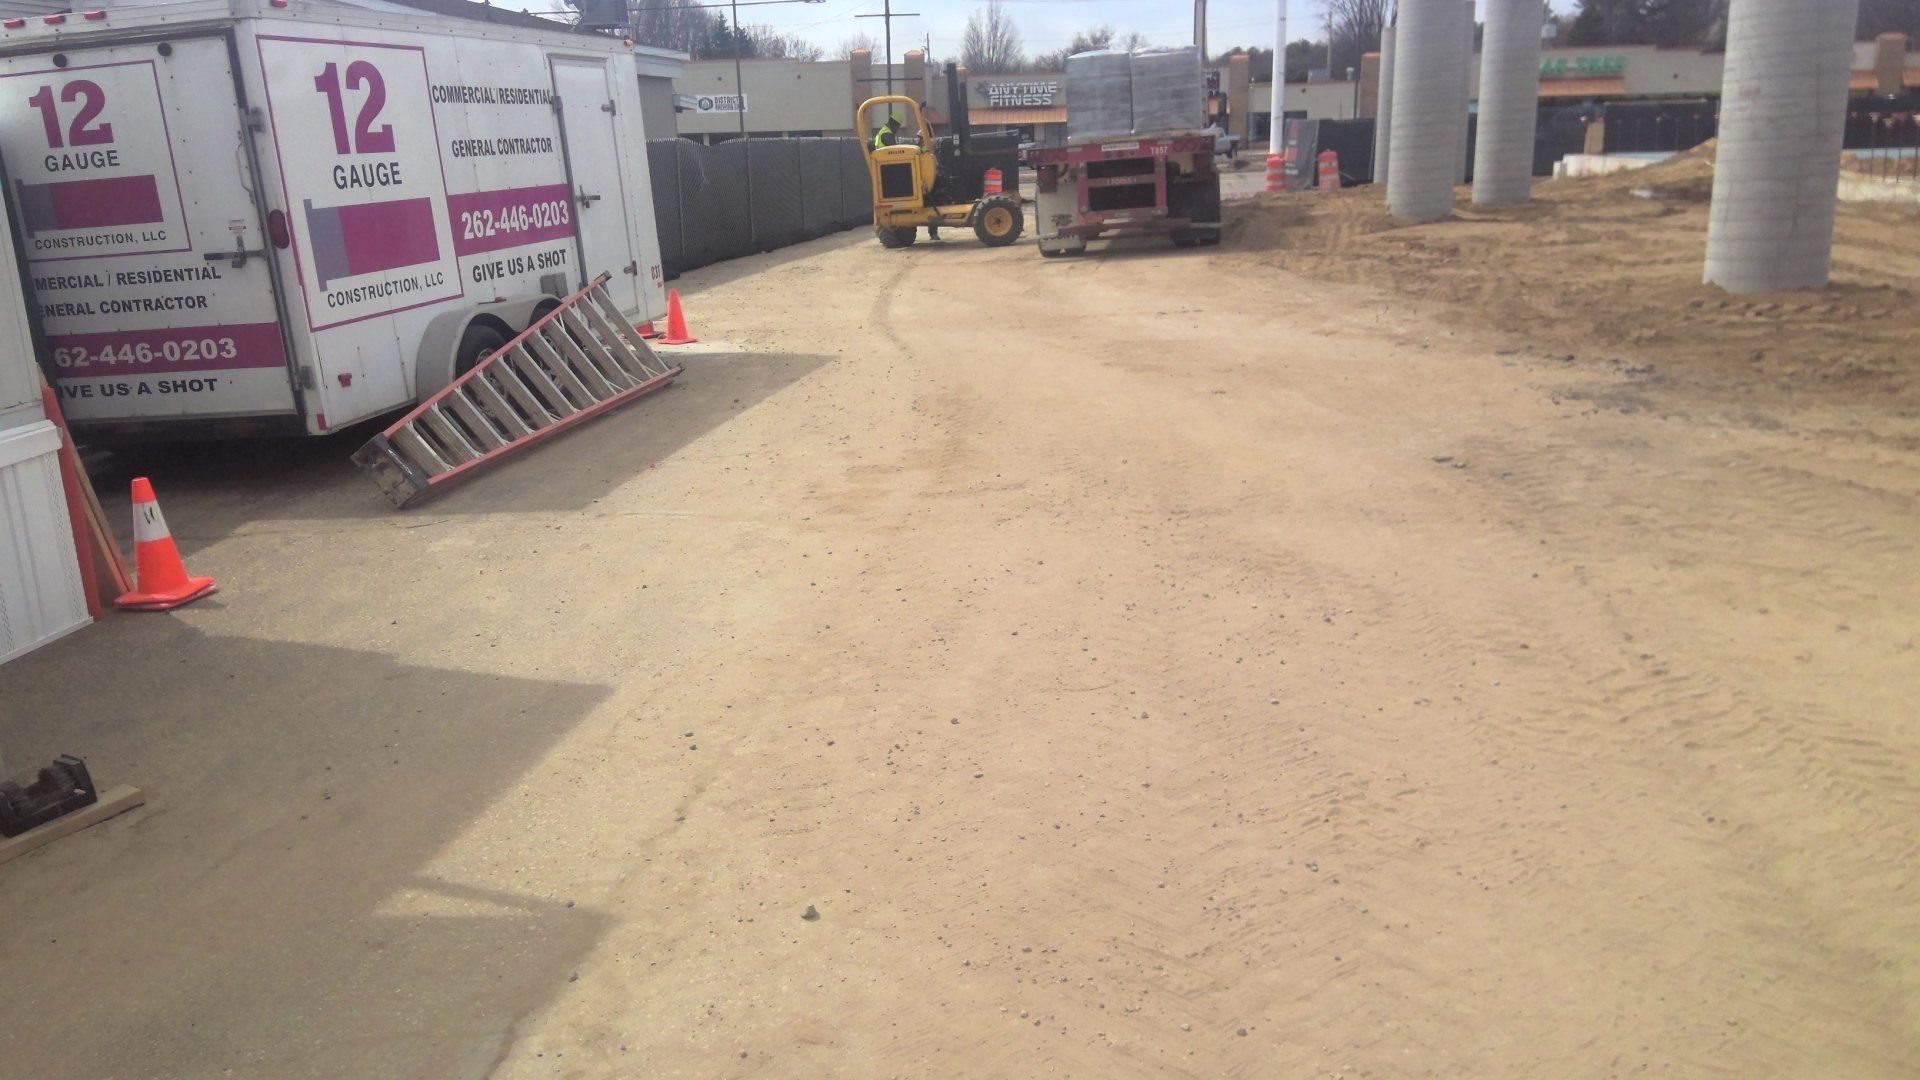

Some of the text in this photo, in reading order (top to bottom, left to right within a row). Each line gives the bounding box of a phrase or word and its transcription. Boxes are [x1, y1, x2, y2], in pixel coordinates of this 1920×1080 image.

[431, 85, 496, 104] COMMERCIAL
[499, 88, 552, 105] RESIDENTIAL
[988, 81, 1058, 95] ANYTIME
[313, 60, 396, 154] 12
[990, 93, 1052, 106] FITNESS
[28, 79, 114, 148] 12
[451, 137, 554, 158] GENERAL CONTRACTOR
[44, 149, 121, 172] GAUGE
[333, 161, 403, 190] GAUGE
[461, 200, 570, 240] 262-446-0203
[34, 230, 167, 250] CONSTRUCTION, LLC
[116, 266, 222, 286] RESIDENTIAL
[472, 248, 567, 283] GIVE US A SHOT
[327, 271, 444, 308] CONSTRUCTION, LLC
[99, 295, 209, 314] CONTRACTOR
[100, 382, 130, 398] US
[137, 381, 152, 395] A
[158, 378, 218, 394] SHOT
